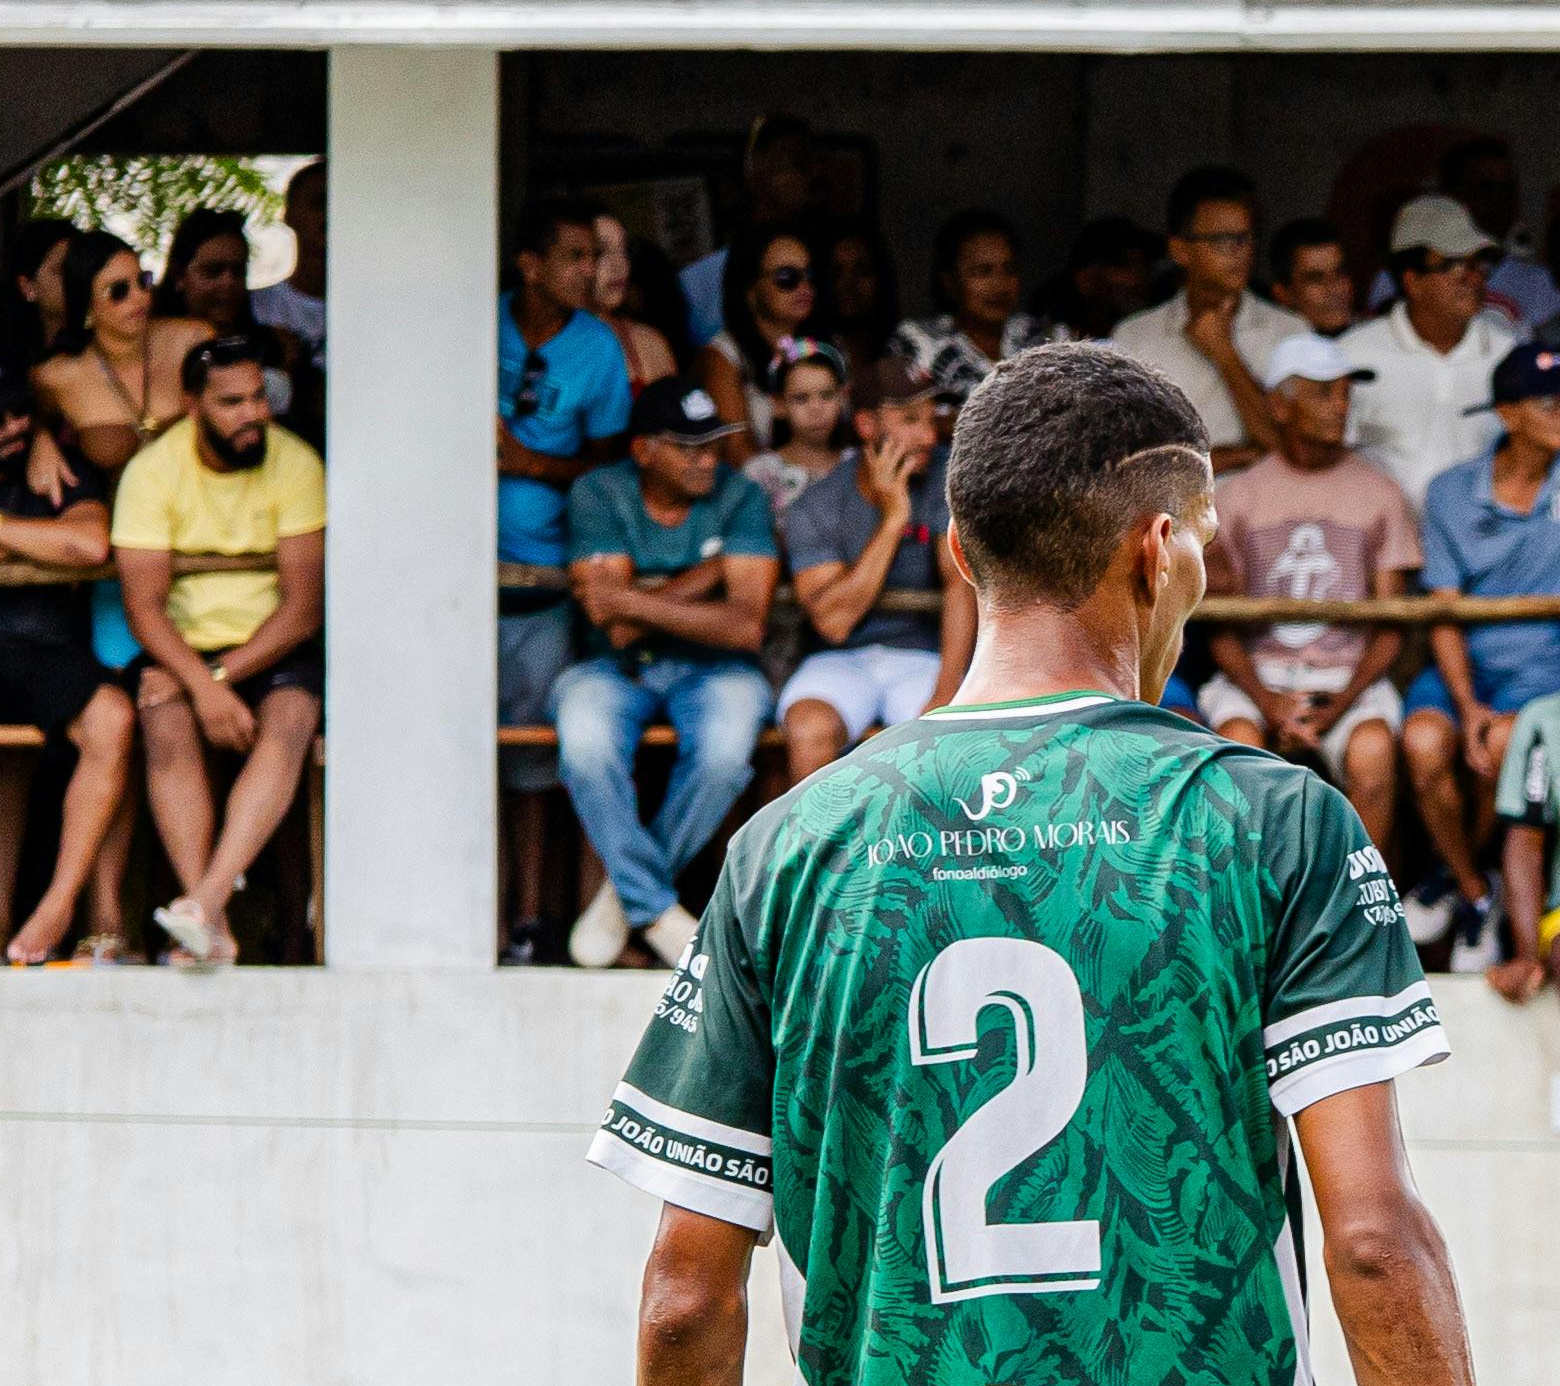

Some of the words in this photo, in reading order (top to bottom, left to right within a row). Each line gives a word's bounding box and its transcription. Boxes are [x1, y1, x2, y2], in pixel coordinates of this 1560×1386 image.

[941, 826, 1026, 856] PEDRO
[1034, 819, 1130, 849] MORAIS
[1280, 1039, 1320, 1071] SÃO
[1324, 1023, 1379, 1059] JOÃO
[1382, 1005, 1440, 1043] UNIÃO
[611, 1115, 665, 1154] JOÃO
[666, 1139, 722, 1172] UNIÃO
[724, 1157, 769, 1186] SÃO
[908, 937, 1101, 1304] 2
